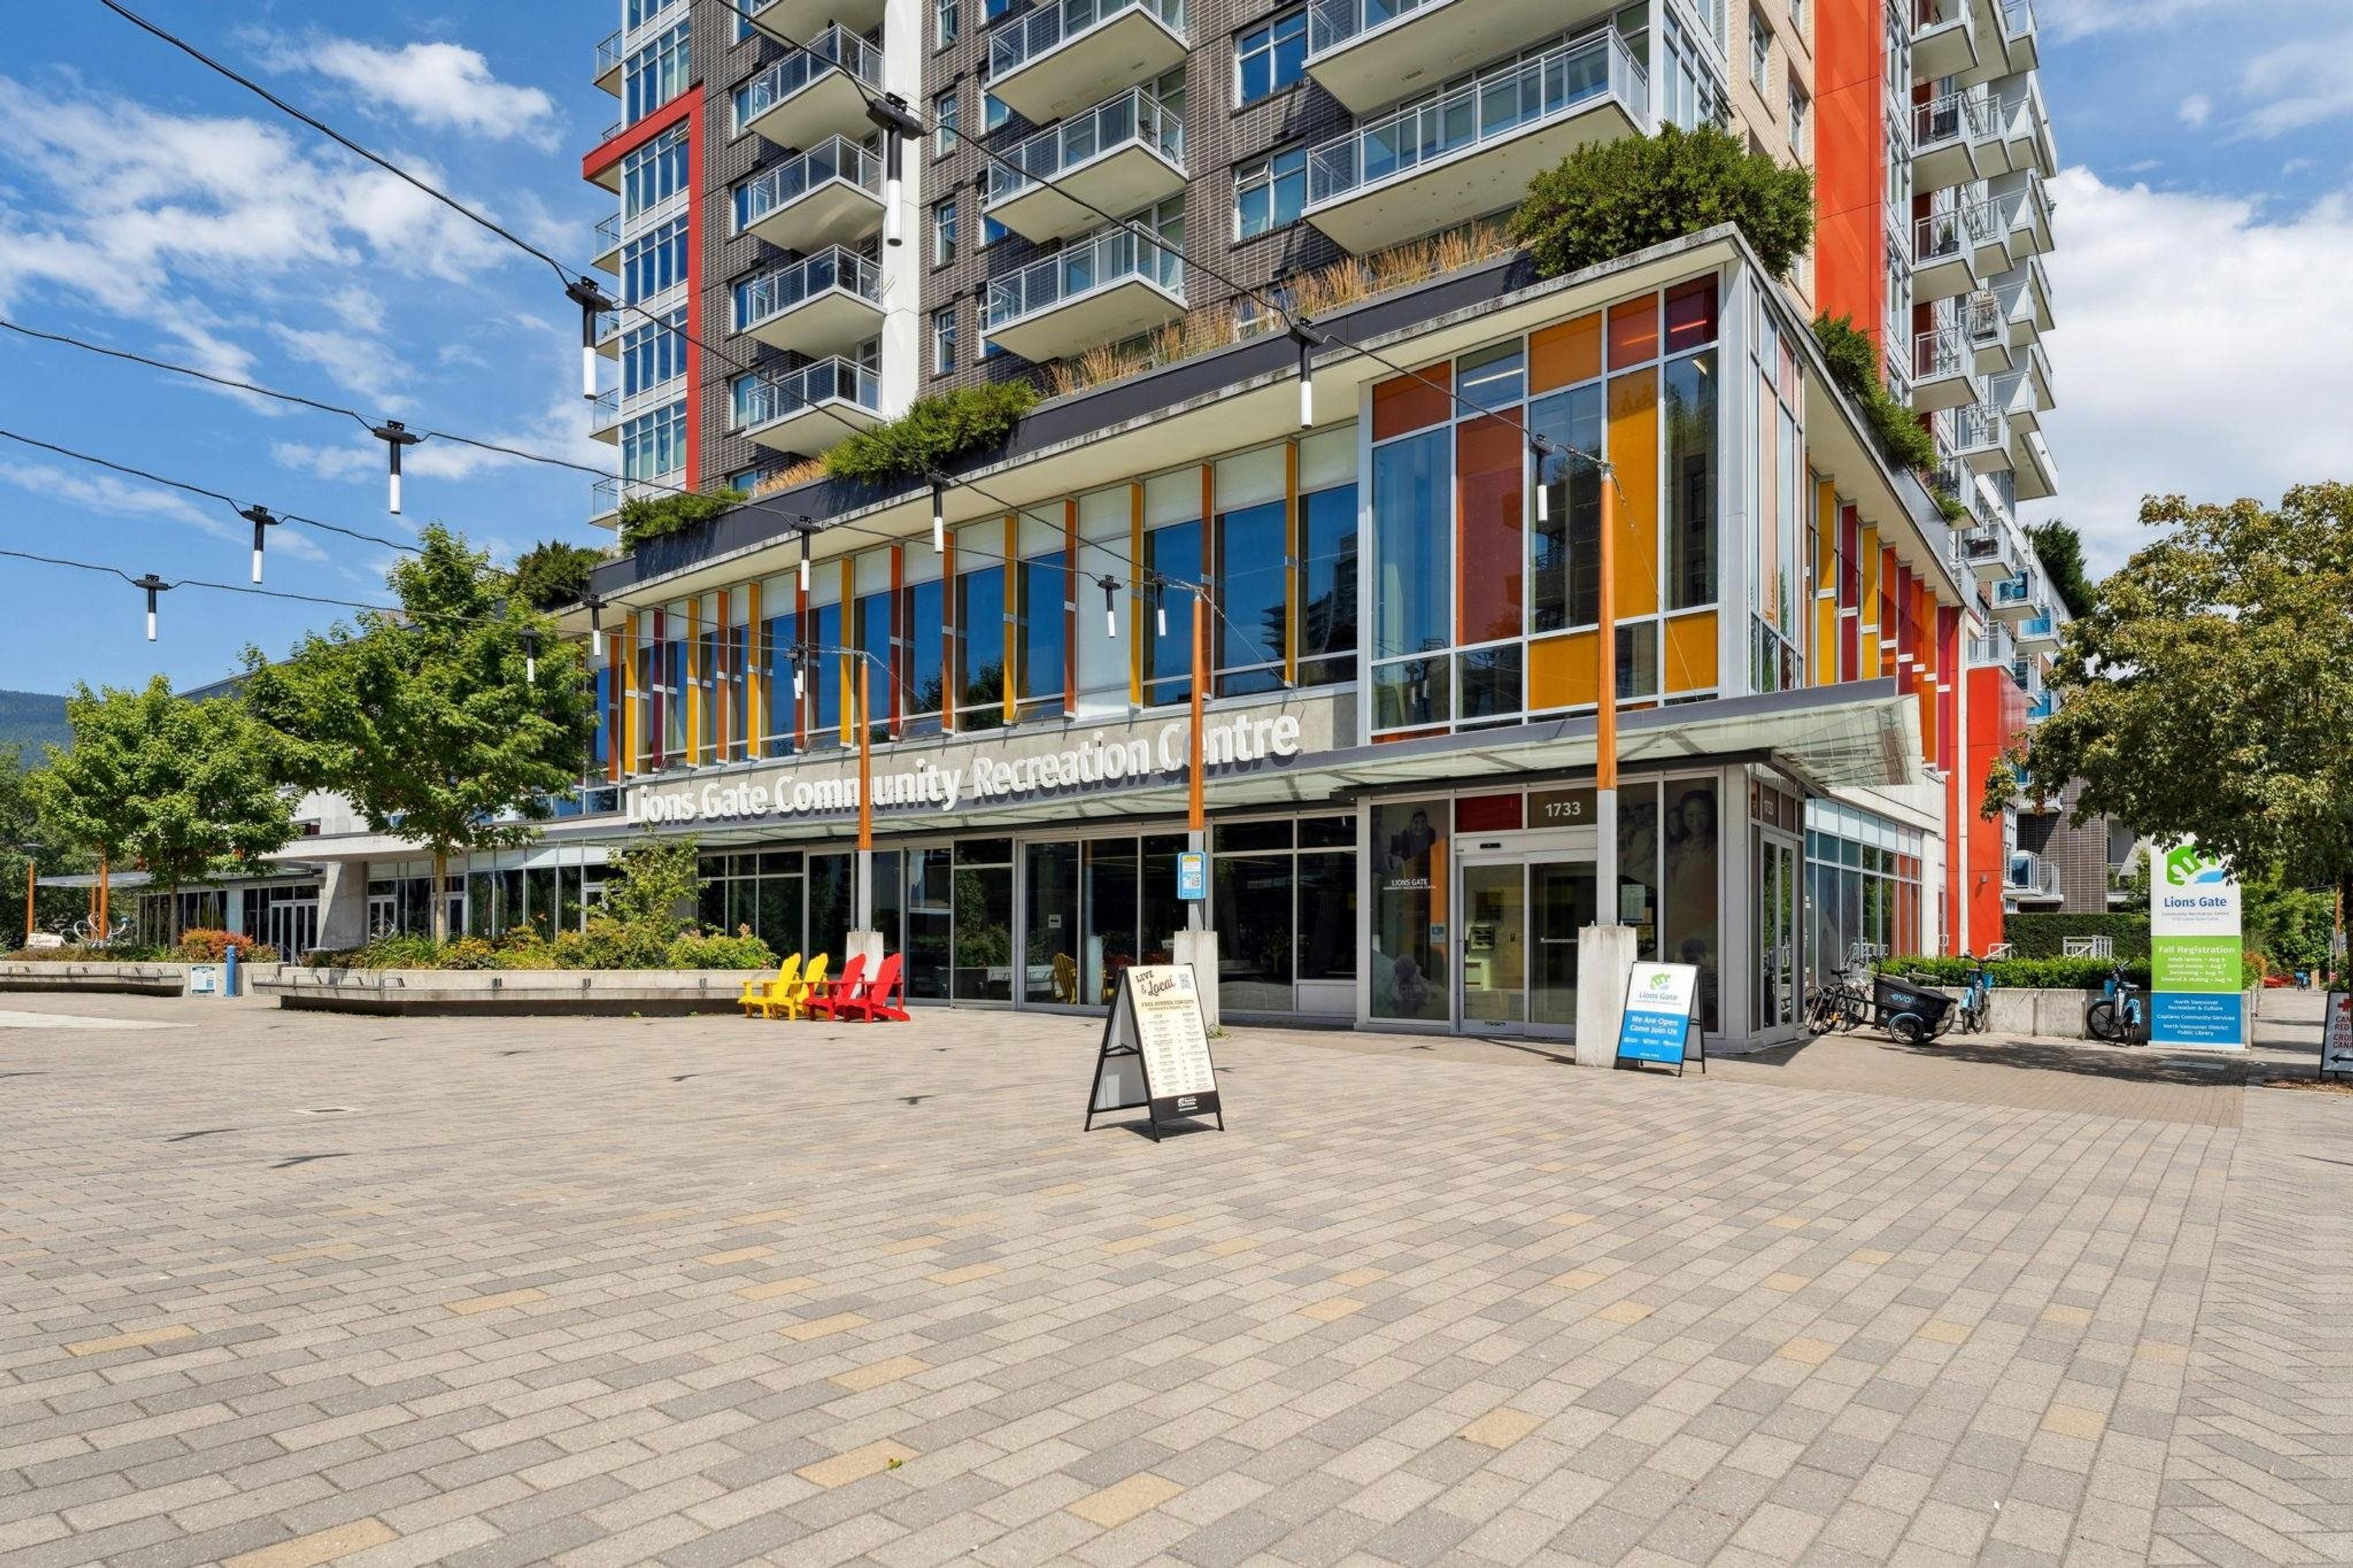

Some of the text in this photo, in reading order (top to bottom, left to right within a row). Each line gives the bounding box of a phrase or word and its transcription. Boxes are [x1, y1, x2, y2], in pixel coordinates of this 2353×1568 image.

[626, 785, 696, 824] Lions
[702, 782, 767, 818] Gate
[775, 758, 961, 813] Community
[974, 731, 1150, 797] Recreation
[1545, 801, 1580, 817] 1733
[2164, 896, 2227, 907] Lions Gate
[2178, 945, 2235, 954] Registration
[1135, 970, 1154, 983] LIVE
[1148, 975, 1175, 996] Local
[1658, 1018, 1678, 1026] Open
